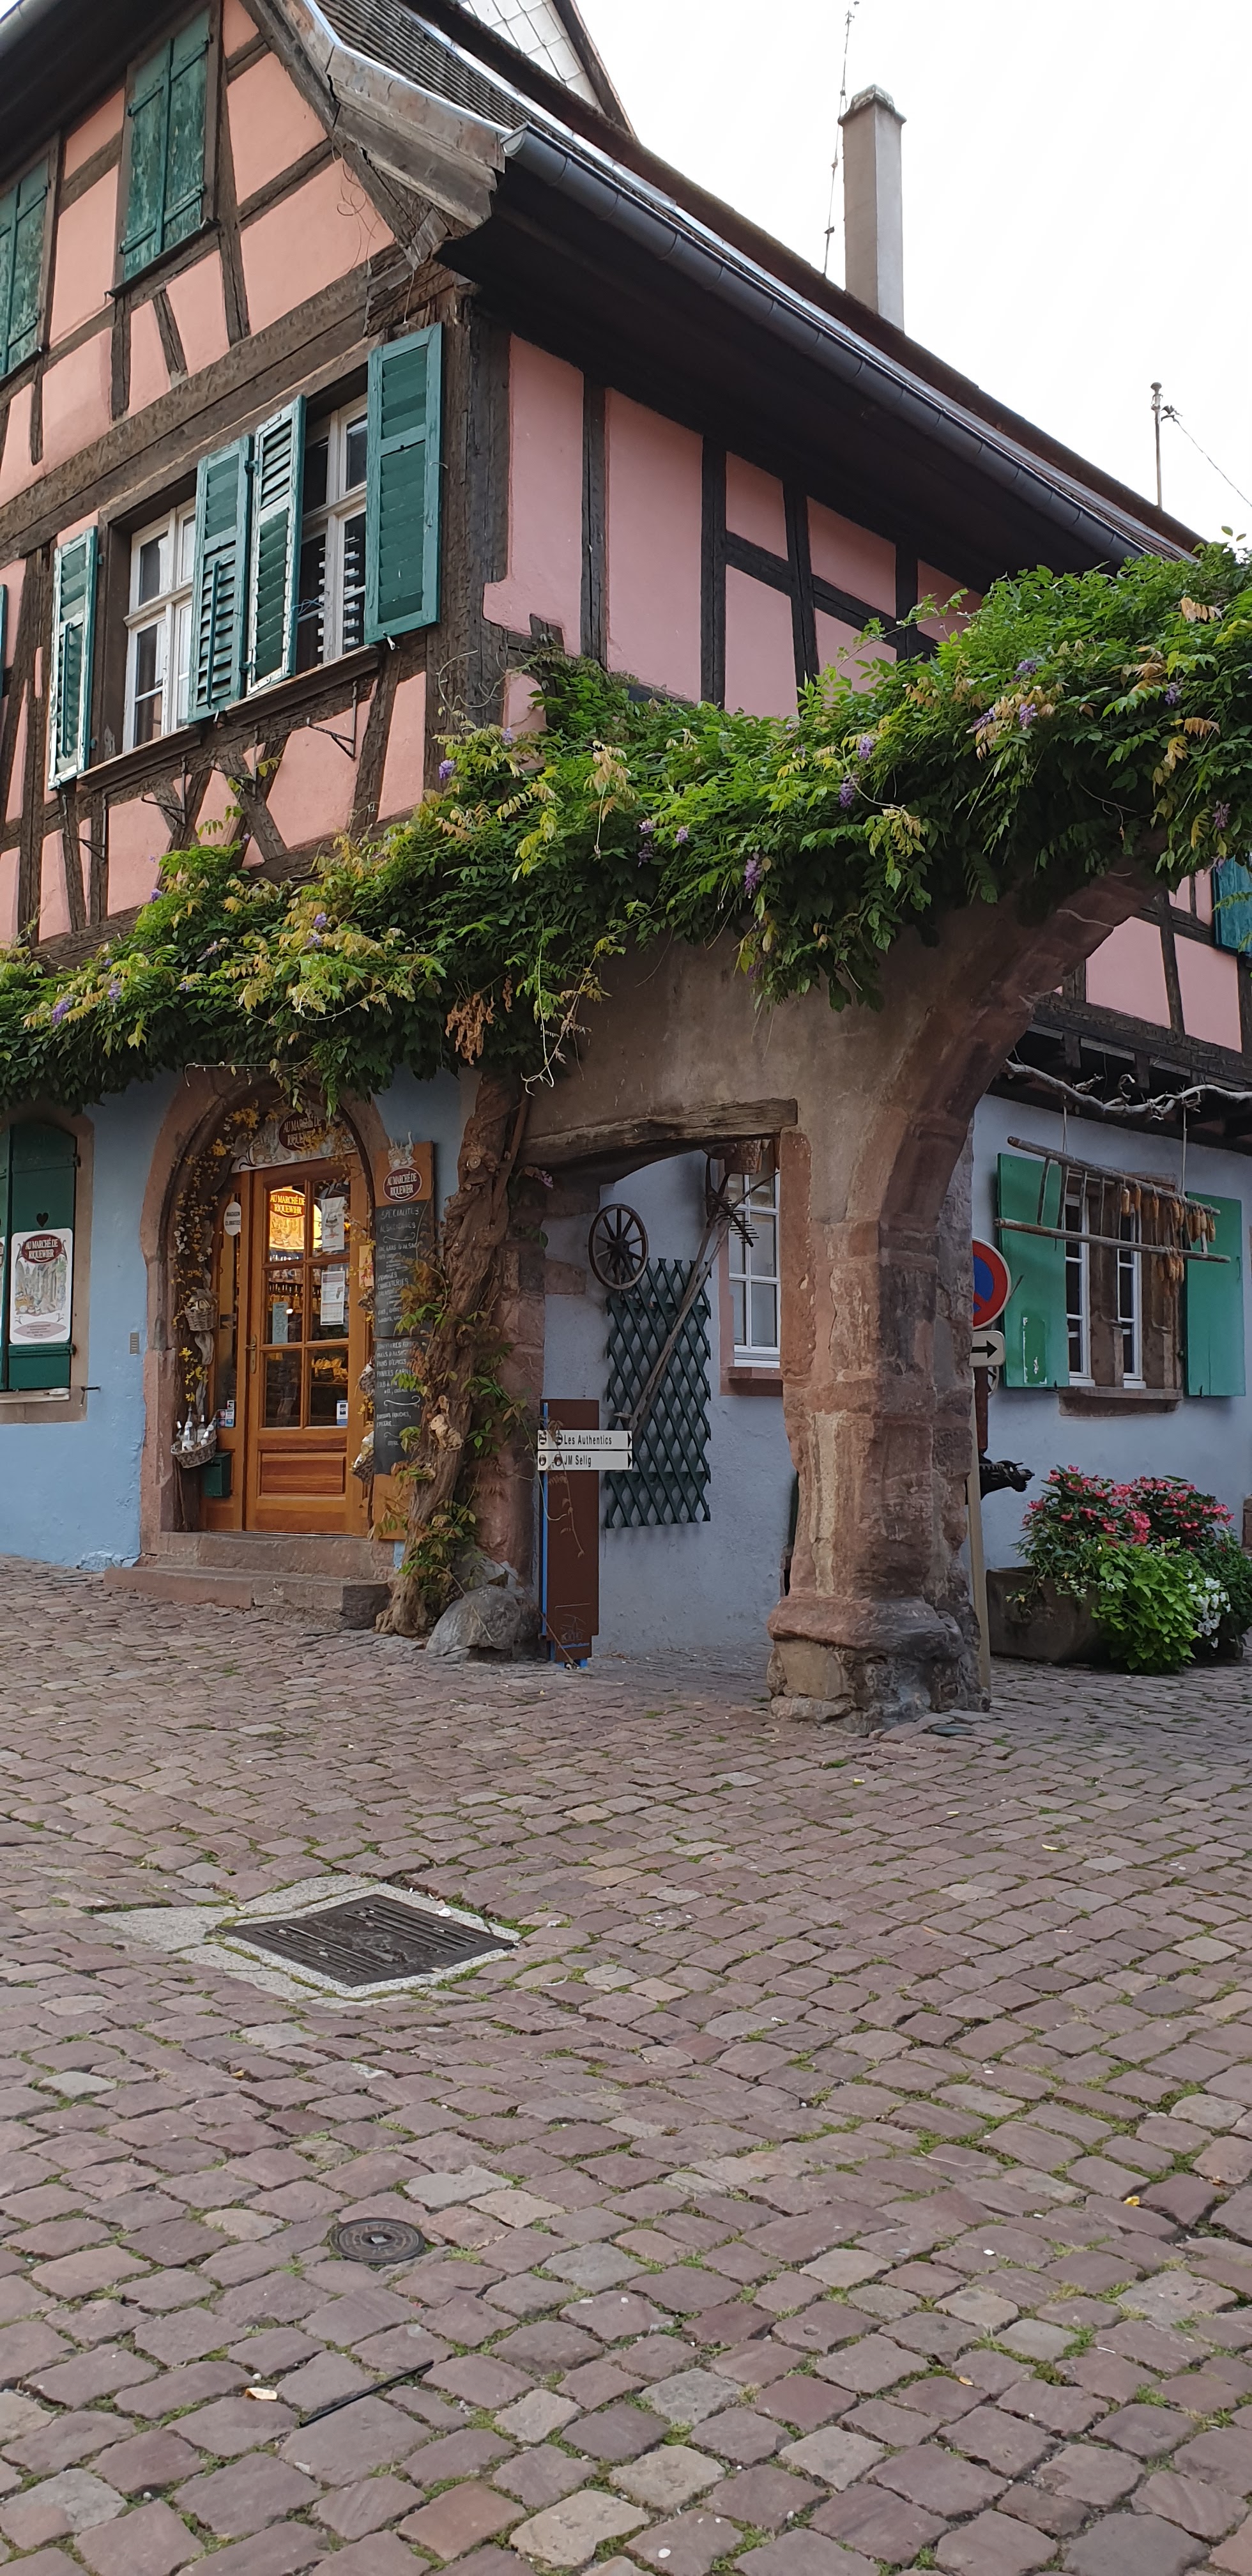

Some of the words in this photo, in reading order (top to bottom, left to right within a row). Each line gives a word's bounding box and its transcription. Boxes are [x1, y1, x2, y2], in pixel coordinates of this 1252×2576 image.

[283, 1121, 291, 1133] AU
[387, 1176, 393, 1186] AU
[393, 1171, 411, 1184] MARCHÉ
[411, 1172, 416, 1182] DE
[270, 1194, 277, 1202] AU
[277, 1195, 298, 1204] MARCHÉ
[298, 1197, 305, 1206] DE
[26, 1241, 33, 1250] AU
[33, 1238, 51, 1249] MARCHÉ
[51, 1239, 58, 1248] DE
[564, 1434, 575, 1445] Les
[577, 1434, 612, 1445] Authentics
[564, 1455, 572, 1465] JM
[575, 1455, 592, 1468] Selig
